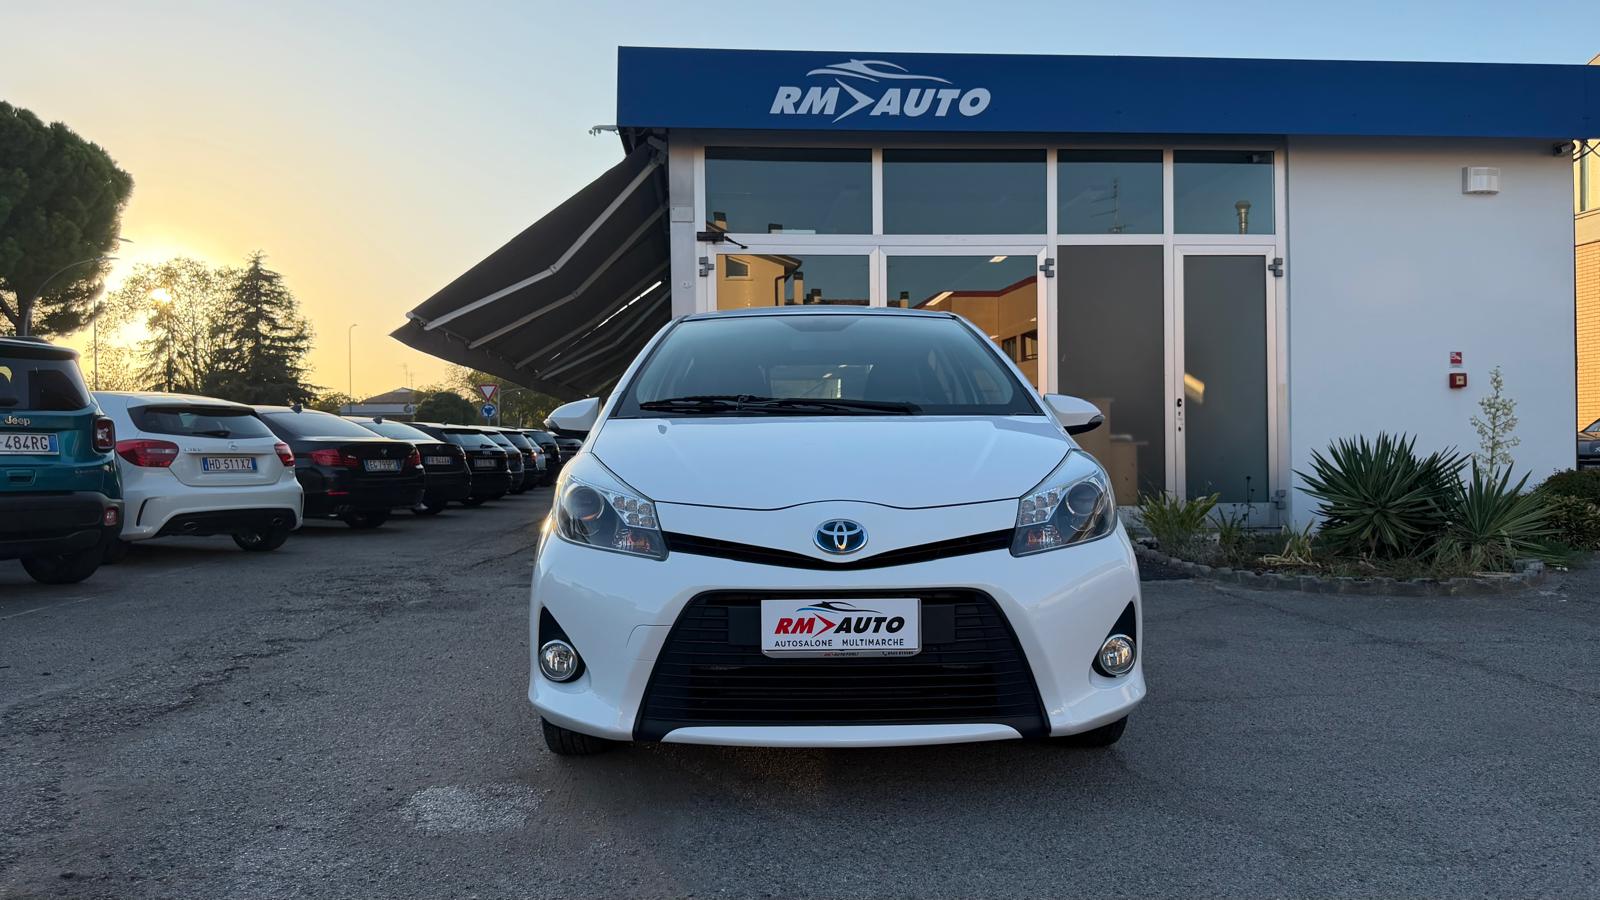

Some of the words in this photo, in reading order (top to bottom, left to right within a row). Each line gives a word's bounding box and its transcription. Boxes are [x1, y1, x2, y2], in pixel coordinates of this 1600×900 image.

[769, 86, 840, 115] RM
[868, 87, 992, 117] AUTO
[4, 415, 31, 426] Jeep
[4, 435, 48, 450] 484RG
[774, 617, 816, 635] RM
[833, 616, 905, 634] AUTO
[774, 639, 833, 648] AUTOSALONE
[842, 638, 904, 647] MULTIMARCHE
